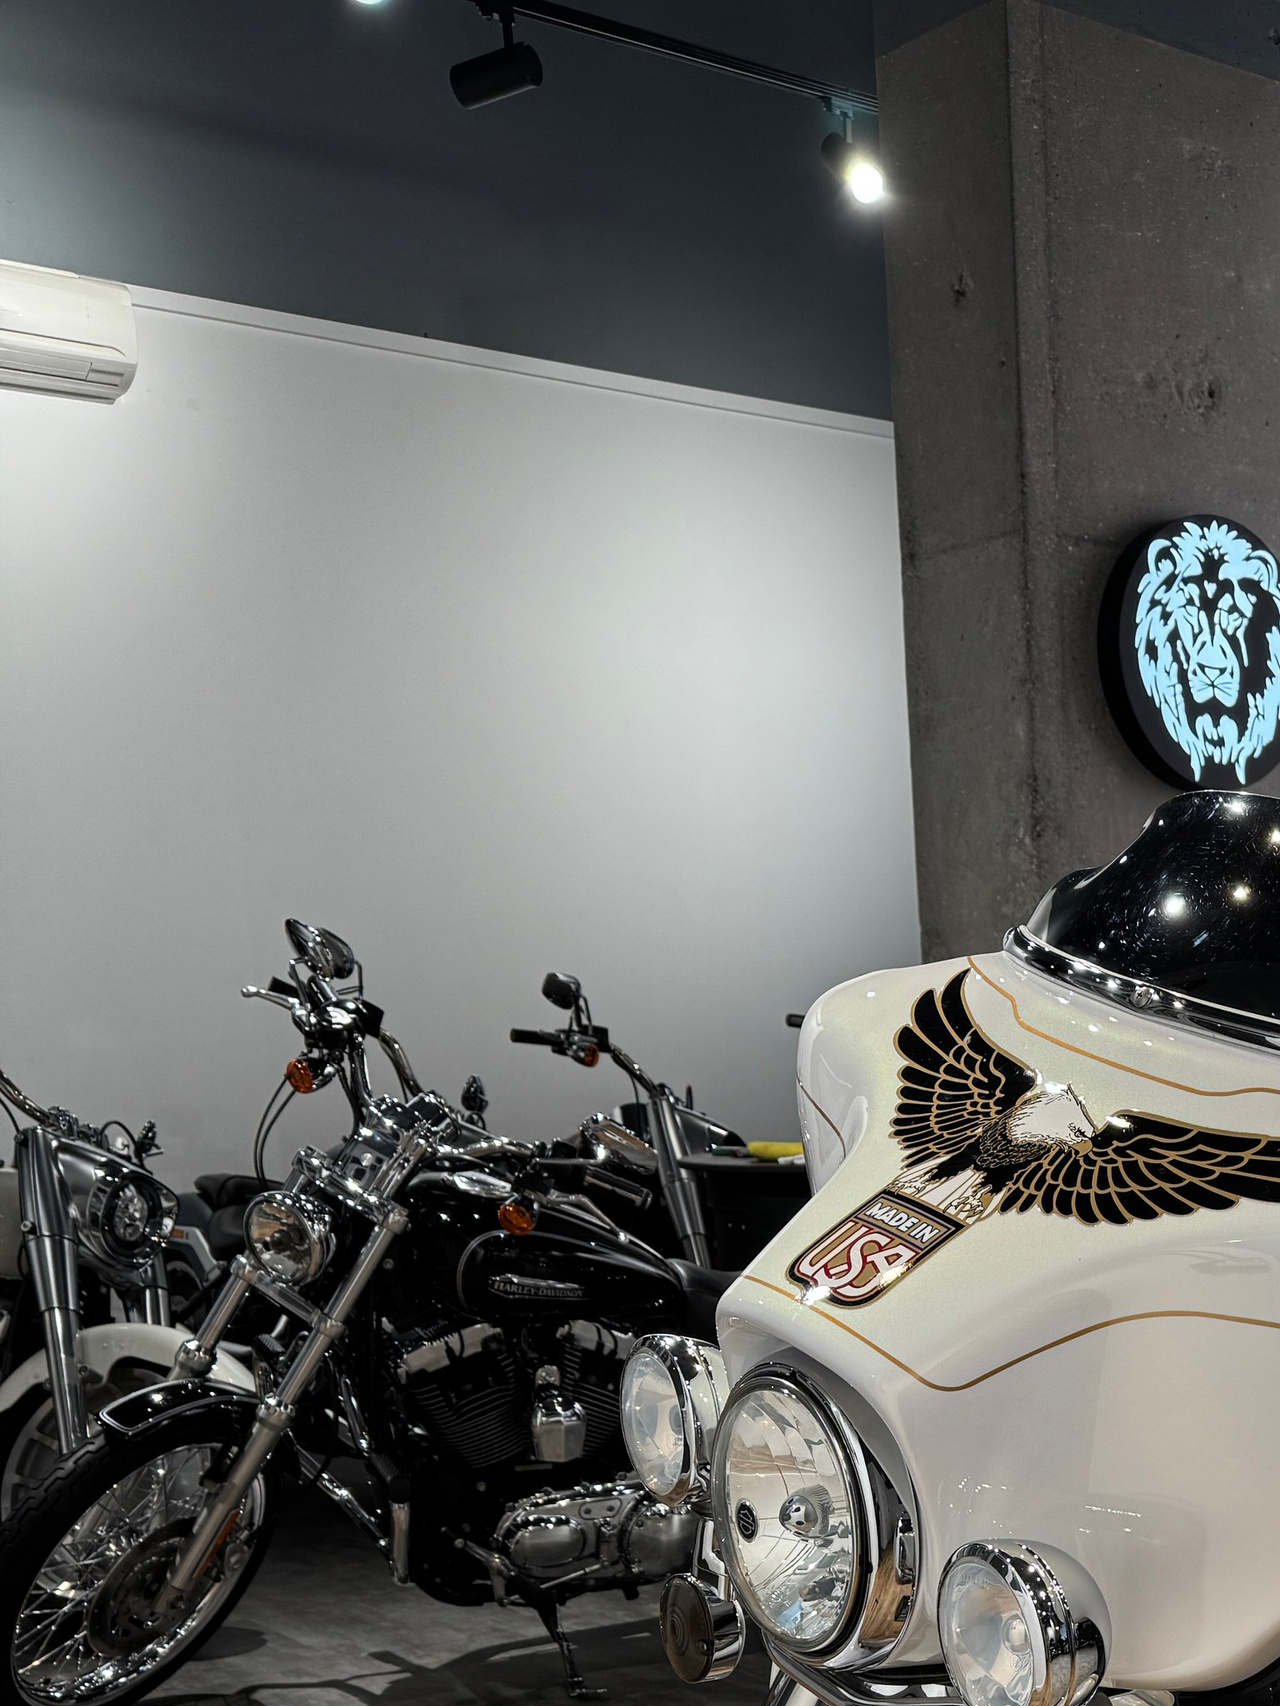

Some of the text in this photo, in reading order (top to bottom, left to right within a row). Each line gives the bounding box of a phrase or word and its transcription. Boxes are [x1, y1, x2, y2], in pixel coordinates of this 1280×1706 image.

[864, 1201, 941, 1243] MADE IN
[798, 1221, 919, 1297] USA
[494, 1281, 583, 1297] HARLEY-DAVIDSON
